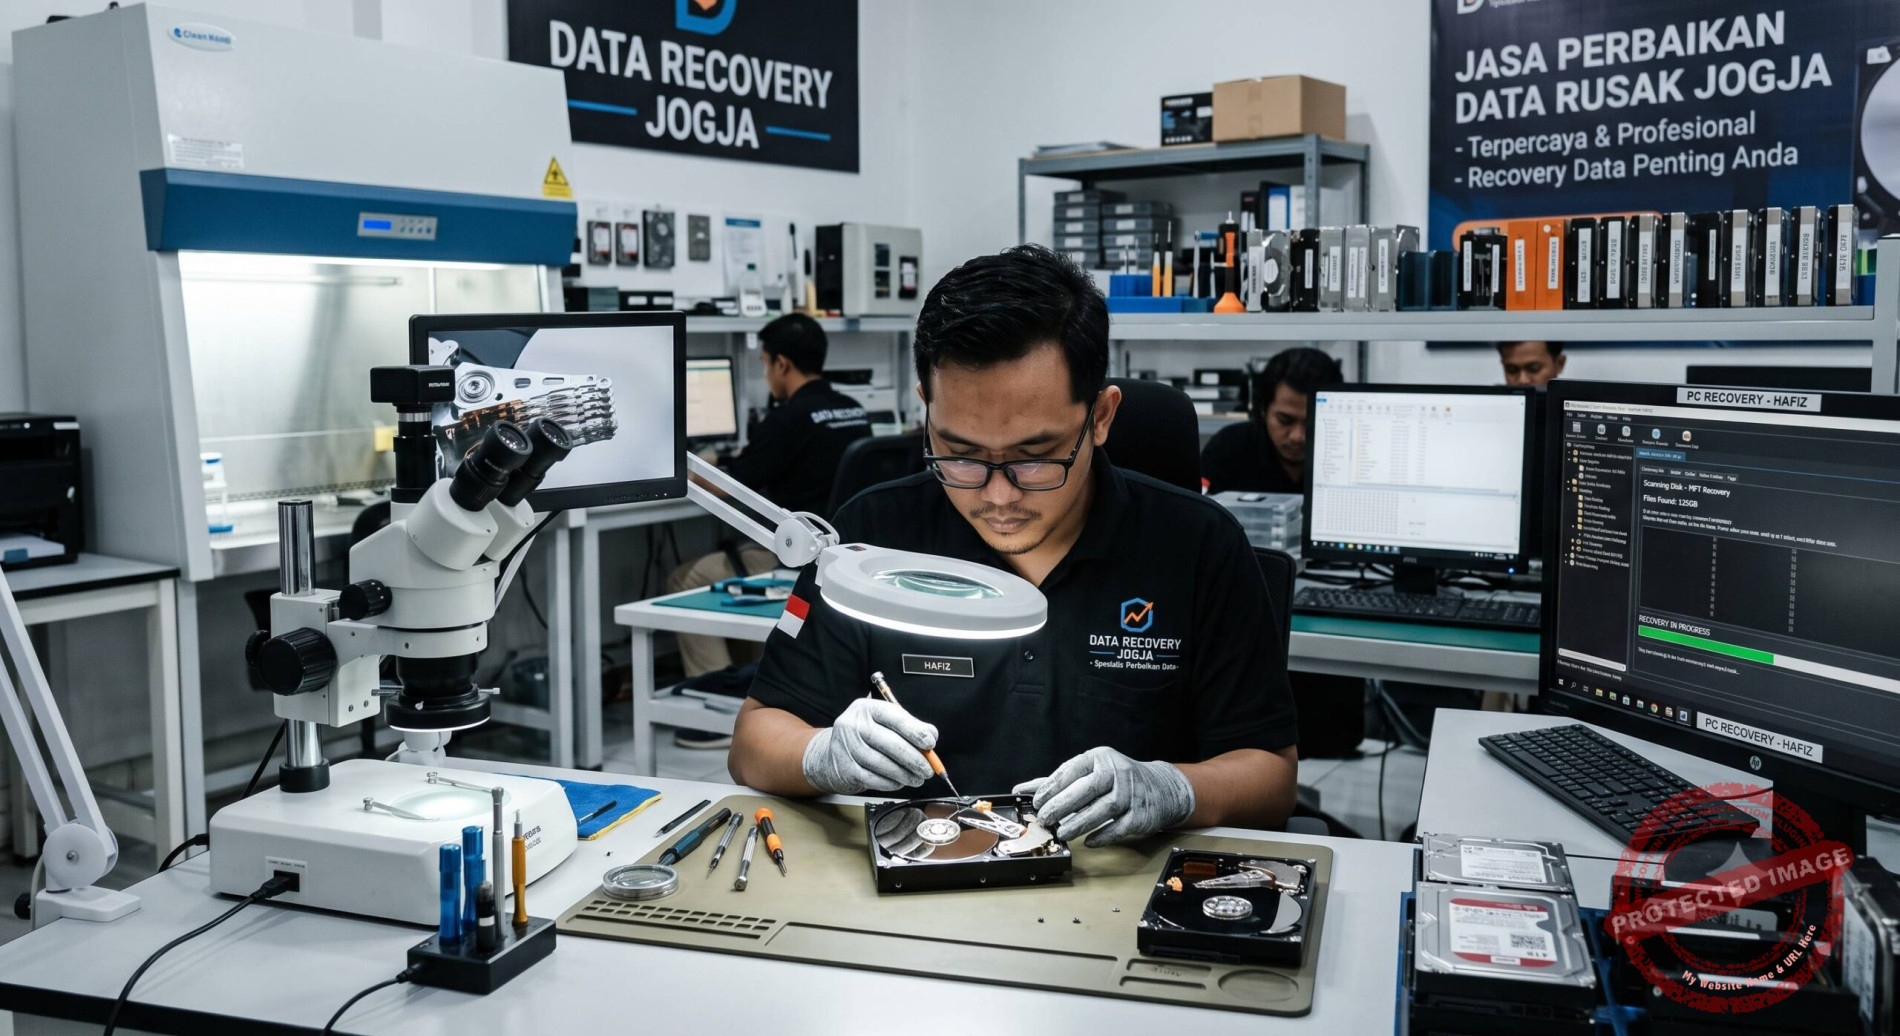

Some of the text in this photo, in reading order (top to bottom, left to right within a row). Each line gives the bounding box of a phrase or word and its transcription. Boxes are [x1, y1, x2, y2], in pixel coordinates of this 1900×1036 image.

[1455, 10, 1784, 82] JASA PERBAIKAN
[550, 20, 832, 109] DATA RECOVERY
[1456, 52, 1832, 124] DATA RUSAK JOGJA
[645, 95, 759, 149] JOGJA
[1467, 131, 1587, 161] Terpercaya
[1594, 124, 1611, 148] &
[1618, 110, 1755, 146] Profesional
[1468, 165, 1567, 189] Recovery
[1574, 158, 1626, 181] Data
[1633, 150, 1725, 177] Penting
[1732, 141, 1798, 169] Anda
[1687, 391, 1701, 401] PC
[1704, 391, 1764, 405] RECOVERY
[1774, 395, 1808, 408] HAFIZ
[1643, 480, 1669, 491] Scanning
[1670, 483, 1683, 491] Disk
[1703, 487, 1731, 498] Recovery
[1657, 496, 1677, 505] Found:
[1639, 615, 1710, 636] RECOVERY IN PROGRESS
[1089, 634, 1182, 650] DATA RECOVERY
[1117, 649, 1154, 661] JOGJA
[924, 662, 951, 671] HAFIZ
[1705, 718, 1718, 730] PC
[1721, 722, 1775, 745] RECOVERY
[1783, 739, 1813, 756] HAFIZ
[1750, 756, 1761, 770] hp
